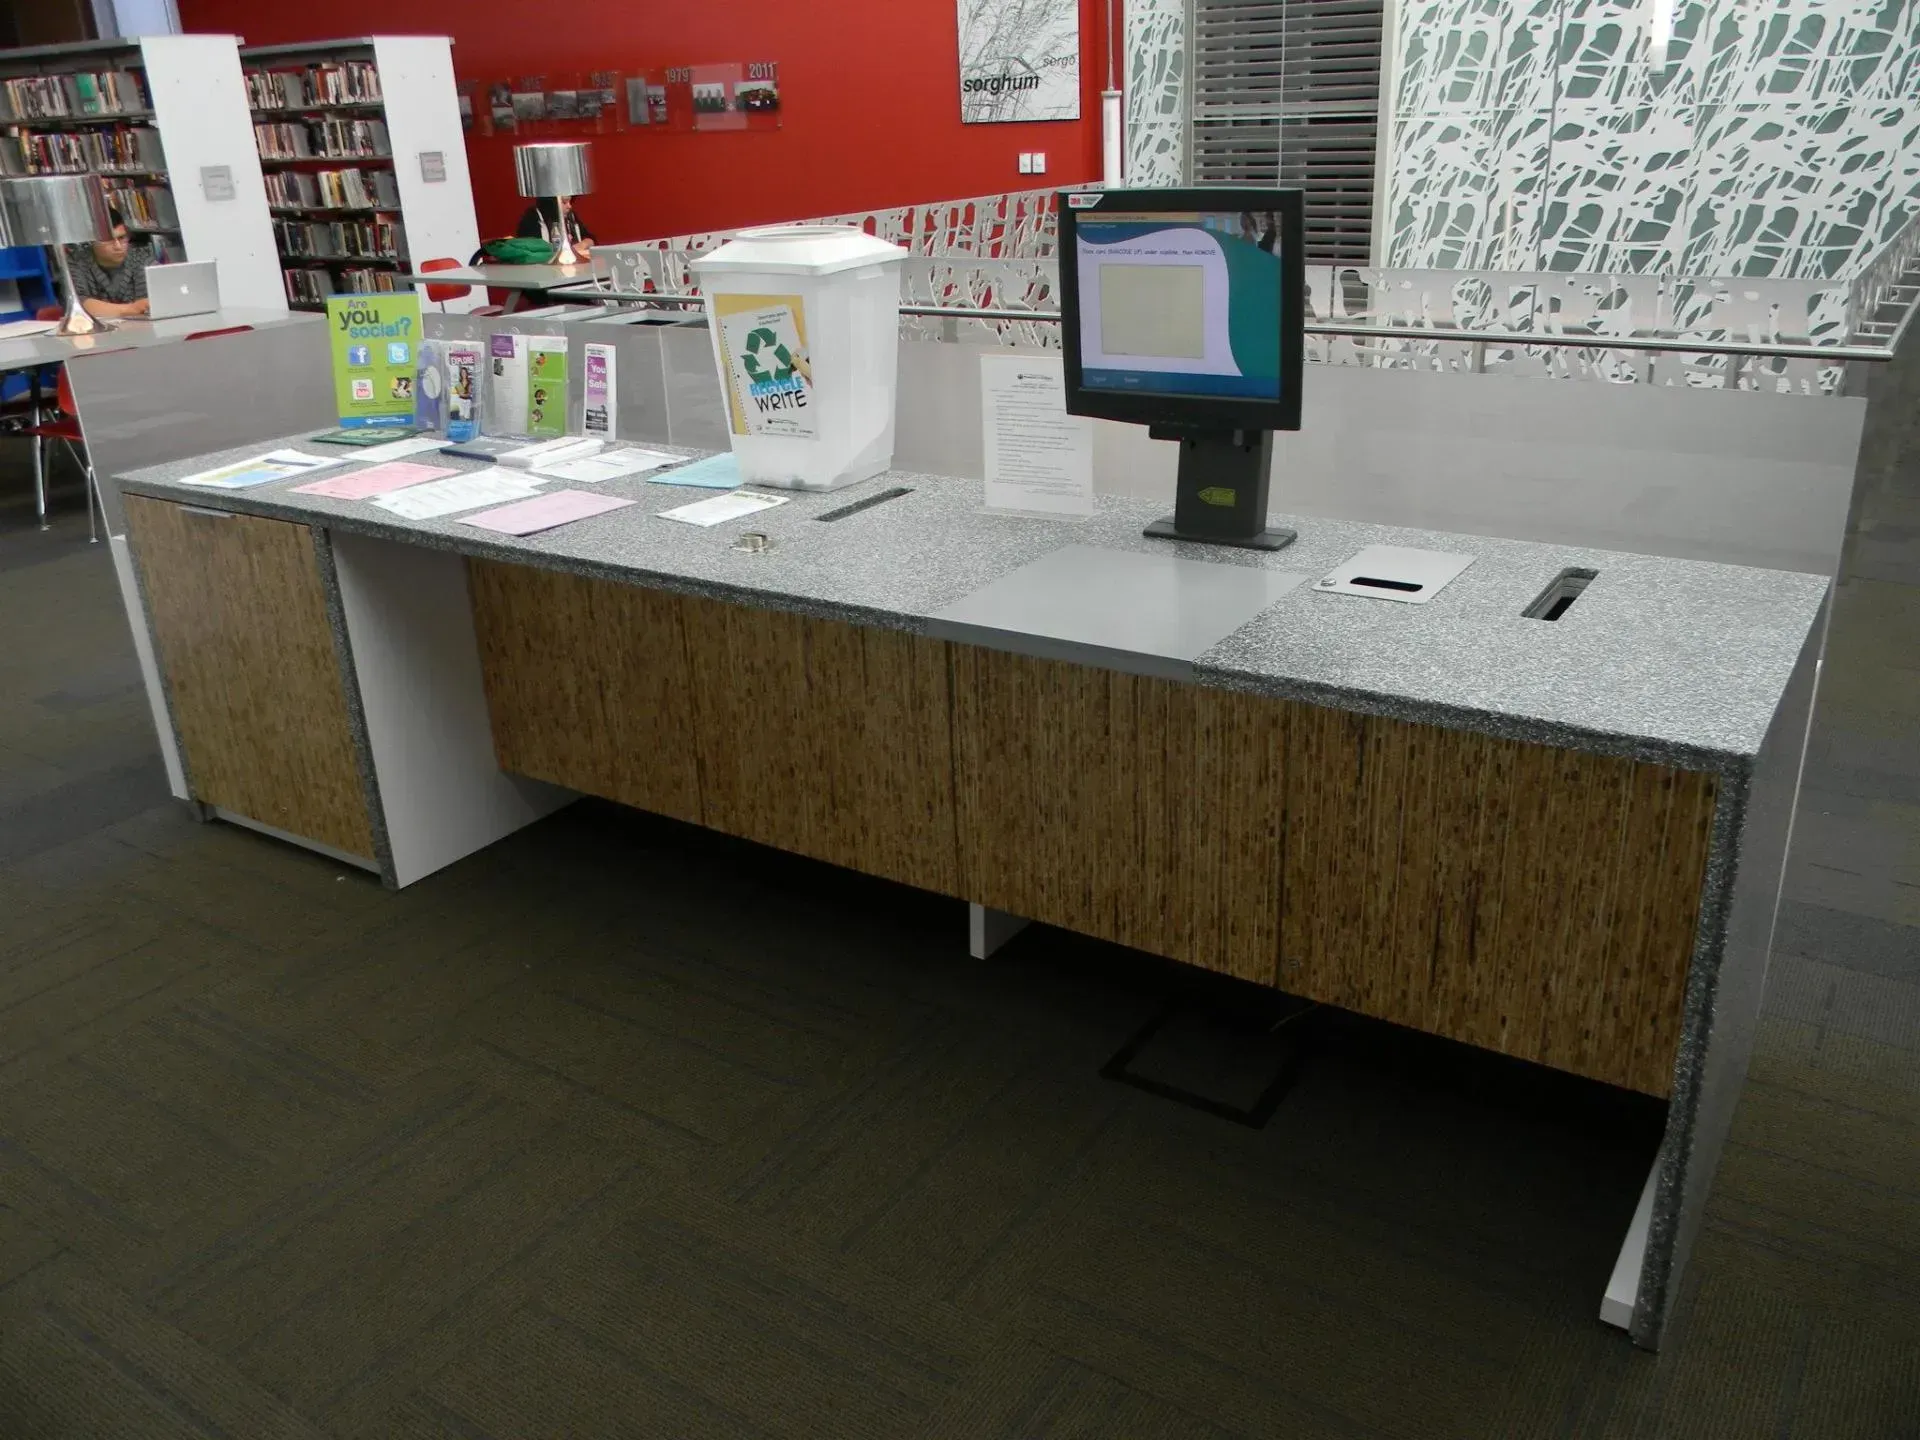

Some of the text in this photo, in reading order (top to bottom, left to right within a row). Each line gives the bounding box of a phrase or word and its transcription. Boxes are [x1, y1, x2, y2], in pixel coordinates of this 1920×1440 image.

[665, 68, 689, 83] 1979
[749, 63, 774, 80] 2011
[963, 72, 1040, 96] sorghum
[348, 299, 367, 309] Are
[338, 309, 380, 331] you
[350, 316, 412, 338] social?
[755, 389, 807, 413] WRITE
